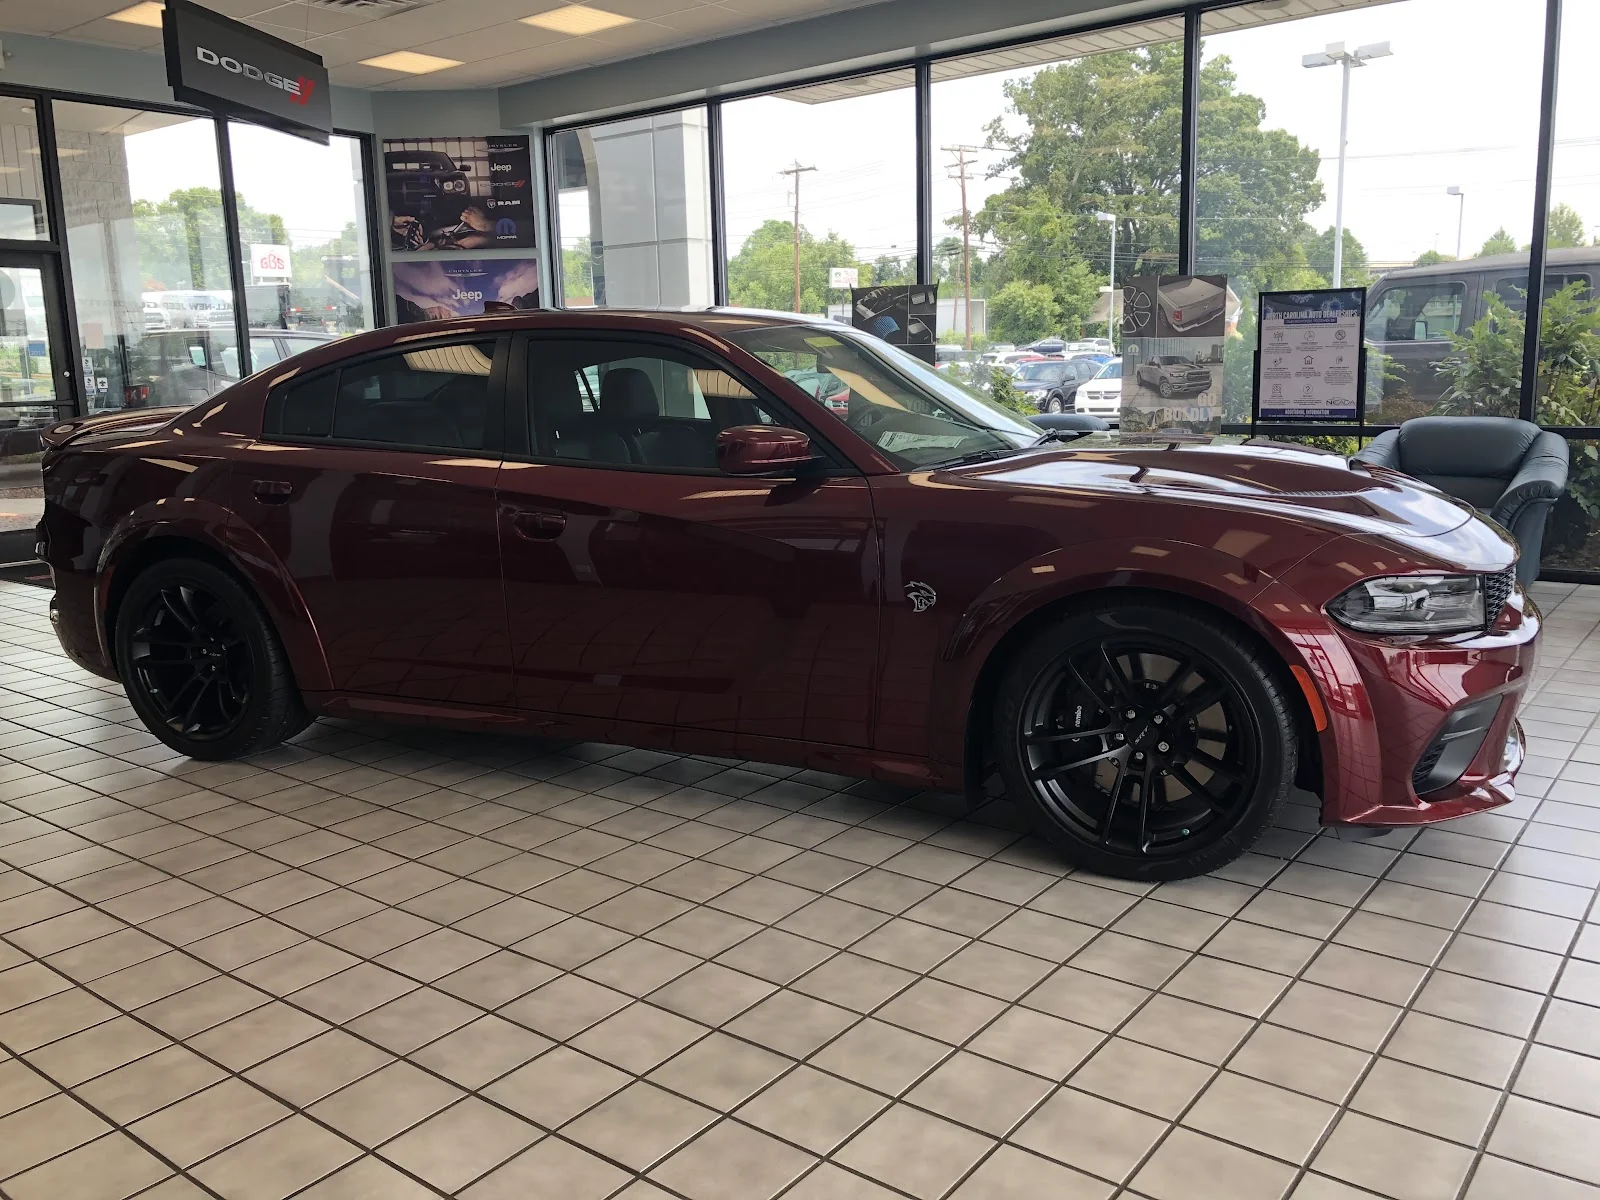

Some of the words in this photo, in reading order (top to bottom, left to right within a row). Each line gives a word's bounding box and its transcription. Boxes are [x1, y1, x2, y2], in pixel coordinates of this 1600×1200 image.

[196, 46, 301, 96] DODGE
[490, 162, 512, 173] Jeep
[452, 288, 483, 302] Jeep
[1197, 392, 1216, 407] GO
[1163, 407, 1214, 422] BOLDLY
